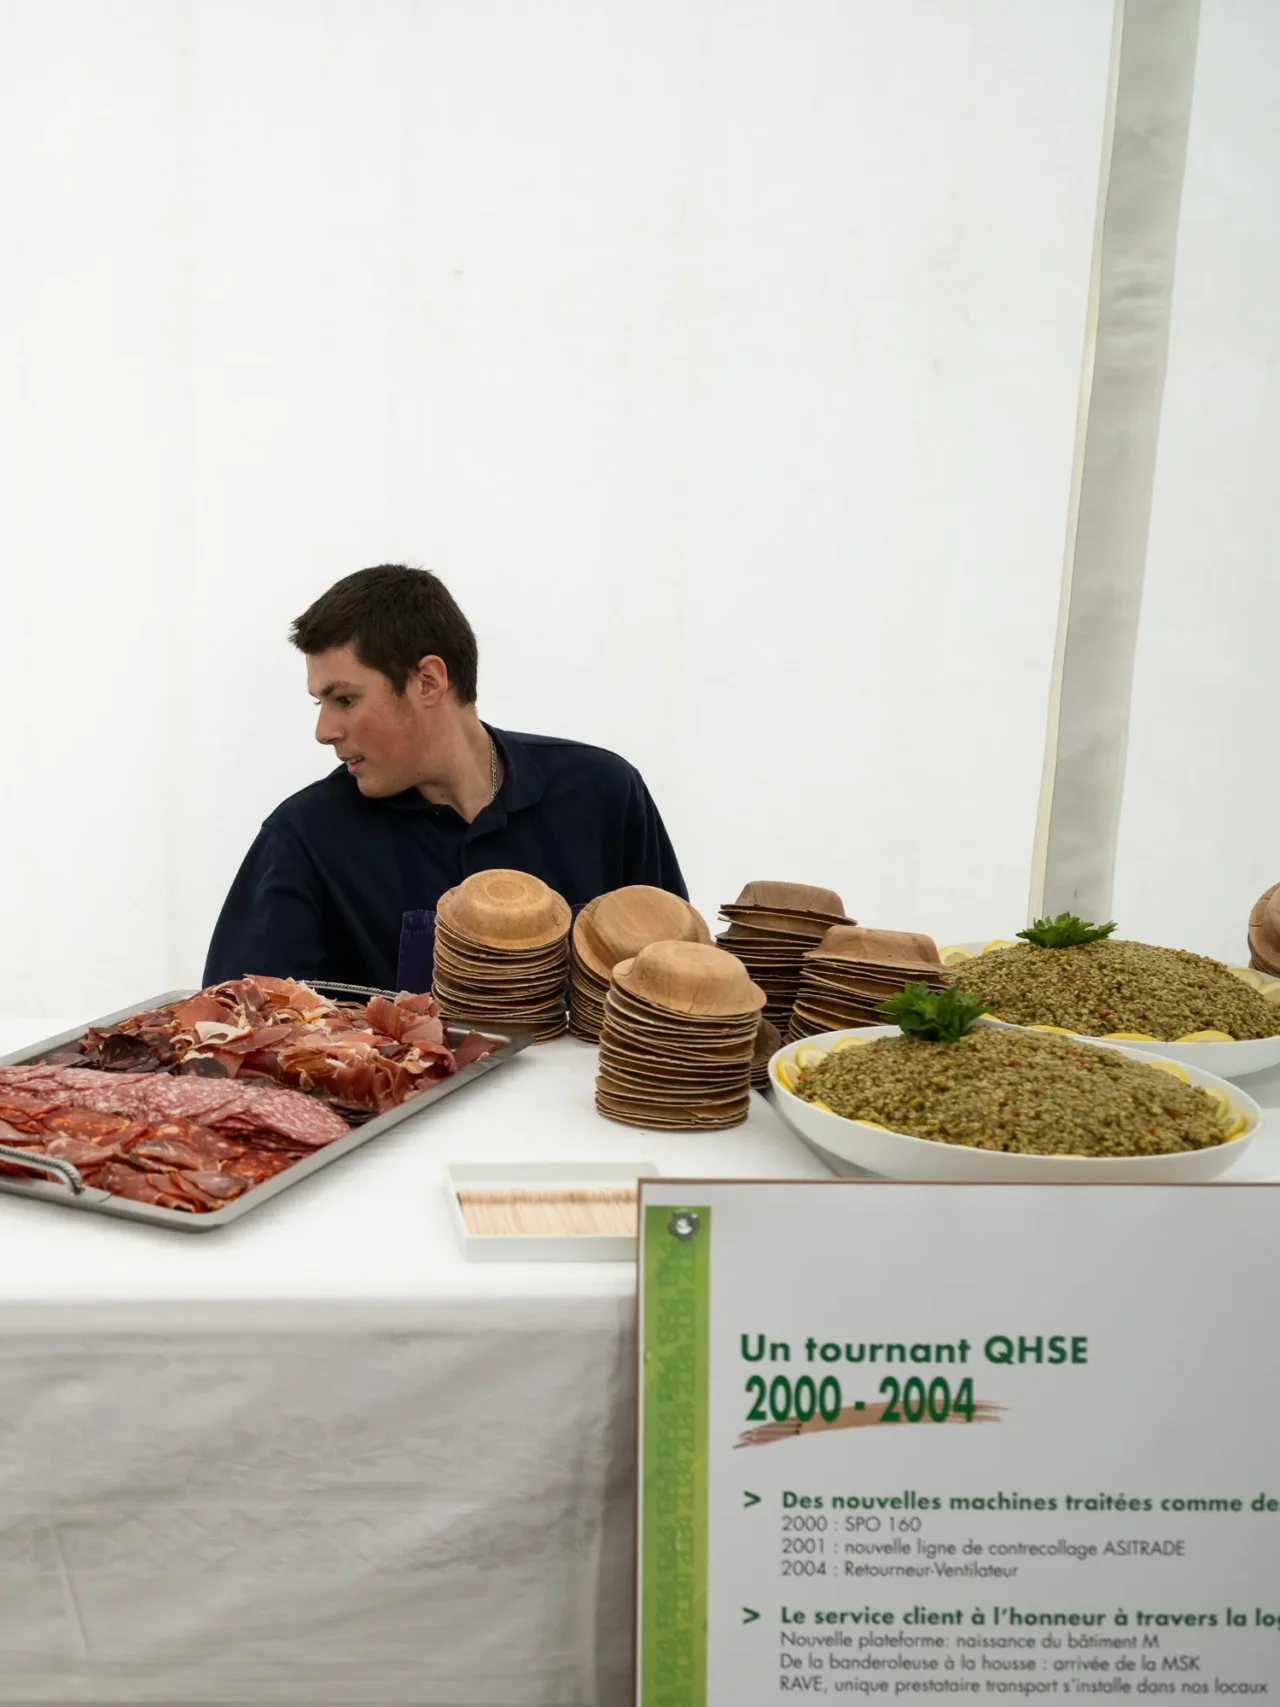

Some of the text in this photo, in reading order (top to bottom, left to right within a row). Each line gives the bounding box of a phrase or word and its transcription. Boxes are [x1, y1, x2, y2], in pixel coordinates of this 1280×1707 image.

[741, 1334, 1088, 1365] Un tournant QHSE
[745, 1374, 842, 1422] 2000
[879, 1375, 977, 1423] 2004
[783, 1491, 823, 1509] Des
[832, 1490, 941, 1510] nouvelles
[950, 1491, 1058, 1511] machines
[1065, 1492, 1153, 1512] traitées
[1161, 1499, 1243, 1512] comme
[782, 1515, 828, 1532] 2000
[845, 1516, 881, 1532] SPO
[890, 1516, 922, 1532] 160
[782, 1537, 824, 1554] 2001
[844, 1538, 911, 1555] nouvelle
[917, 1538, 957, 1559] ligne
[962, 1539, 983, 1555] de
[988, 1539, 1098, 1561] contrecollage
[1103, 1540, 1185, 1556] ASITRADE
[782, 1560, 827, 1576] 2004
[844, 1560, 1019, 1578] Retourneur-Ventilateur
[782, 1606, 805, 1624] Le
[815, 1606, 895, 1625] service
[903, 1606, 963, 1625] client
[971, 1607, 985, 1625] à
[994, 1606, 1107, 1626] l'honneur
[1114, 1608, 1128, 1626] à
[1136, 1611, 1218, 1627] travers
[1226, 1607, 1247, 1627] la
[780, 1631, 853, 1647] Nouvelle
[956, 1634, 1036, 1649] naissance
[1041, 1632, 1062, 1648] du
[1067, 1632, 1138, 1649] bâtiment
[1142, 1634, 1159, 1648] M
[780, 1653, 803, 1669] De
[808, 1652, 823, 1669] la
[829, 1653, 939, 1671] banderoleuse
[944, 1655, 955, 1671] à
[960, 1654, 976, 1671] la
[982, 1654, 1036, 1671] housse
[1053, 1656, 1110, 1671] arrivée
[1115, 1654, 1136, 1671] de
[1141, 1654, 1157, 1672] la
[1162, 1655, 1200, 1672] MSK
[834, 1677, 889, 1696] unique
[895, 1678, 980, 1696] prestataire
[985, 1680, 1058, 1697] transport
[1136, 1677, 1176, 1694] dans
[1181, 1682, 1209, 1694] nos
[1215, 1677, 1268, 1694] locaux
